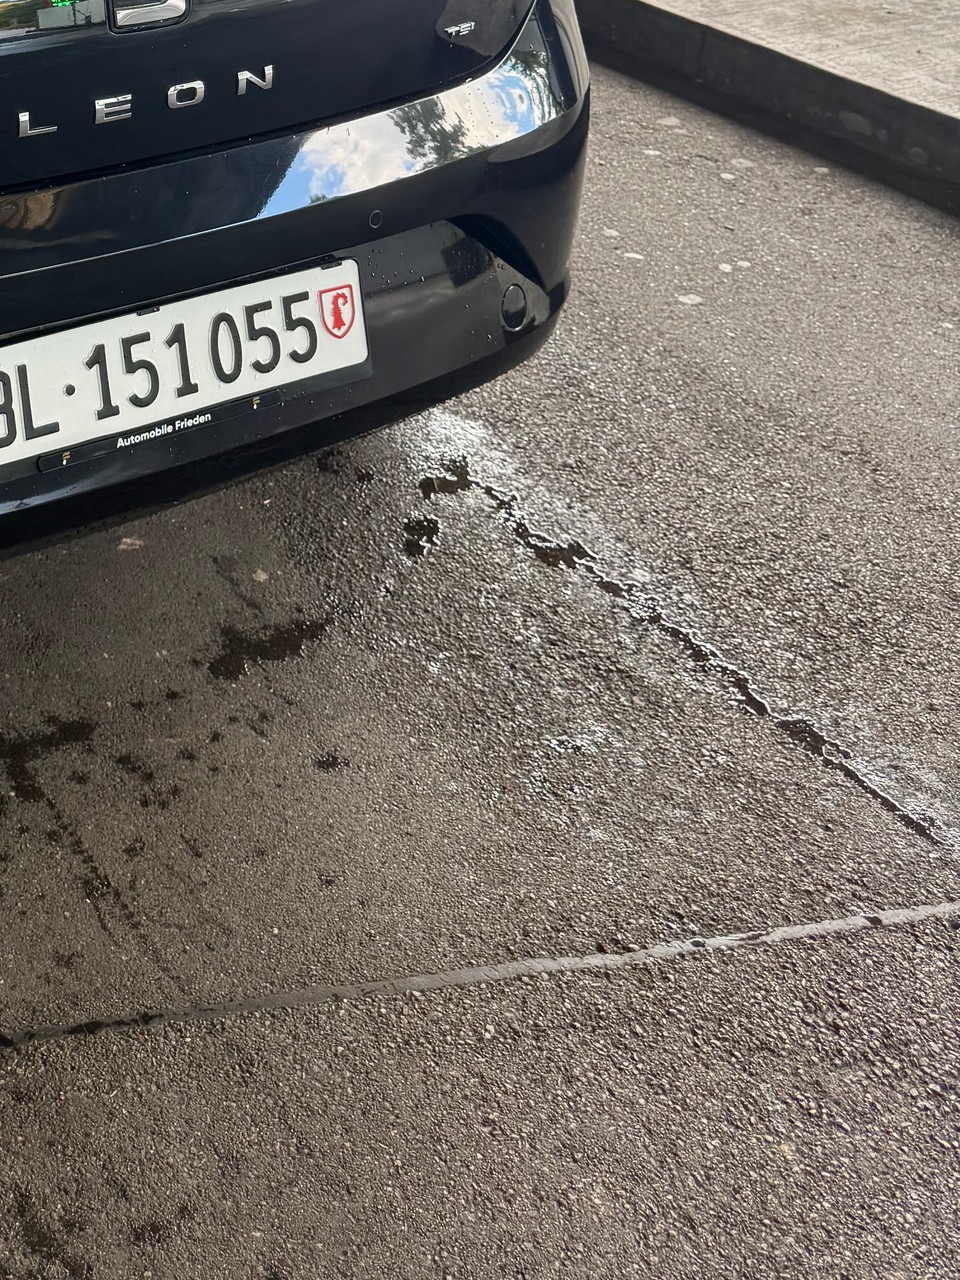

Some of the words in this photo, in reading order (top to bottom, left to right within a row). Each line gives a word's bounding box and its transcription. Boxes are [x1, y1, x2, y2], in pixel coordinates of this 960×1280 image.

[18, 64, 274, 138] LEON
[116, 423, 174, 449] Automobile
[175, 413, 212, 431] Frieden
